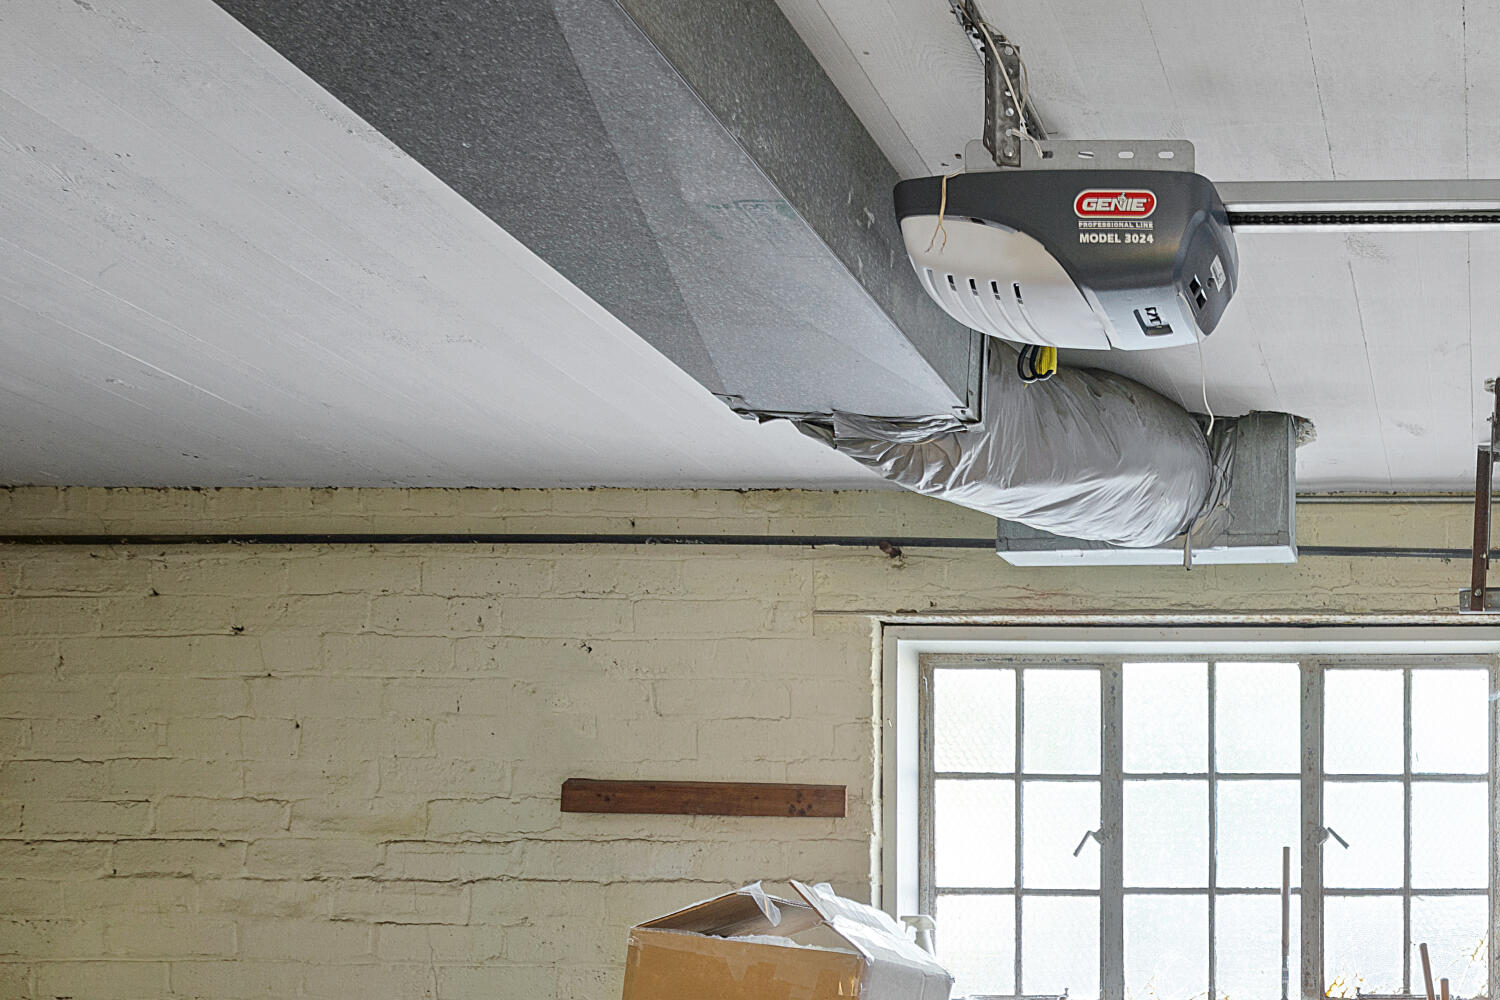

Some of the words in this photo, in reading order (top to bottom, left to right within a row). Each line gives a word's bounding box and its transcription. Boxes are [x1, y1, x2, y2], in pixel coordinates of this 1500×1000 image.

[1082, 196, 1147, 212] GENIE
[1080, 233, 1122, 244] MODEL
[1124, 233, 1154, 244] 3024
